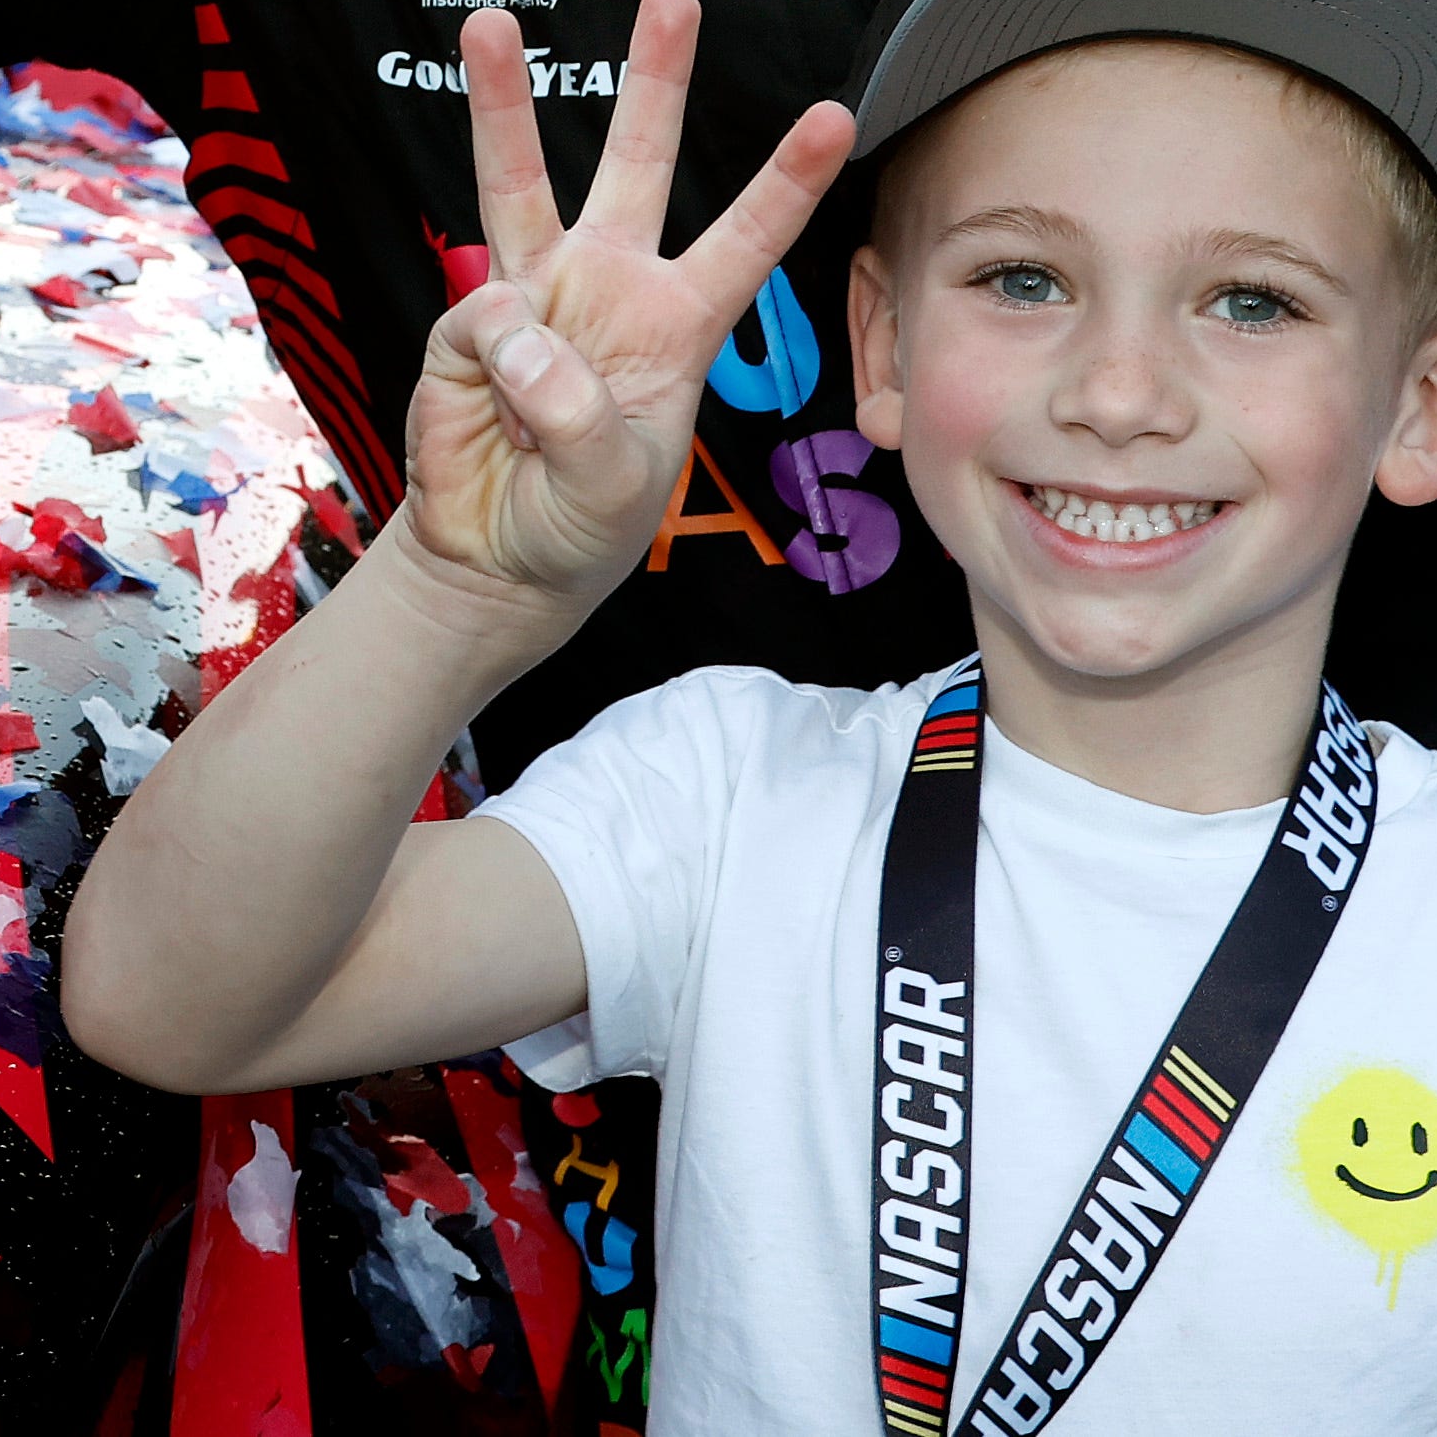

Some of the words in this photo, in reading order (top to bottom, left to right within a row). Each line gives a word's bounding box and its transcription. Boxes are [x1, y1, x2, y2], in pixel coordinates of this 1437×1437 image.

[1281, 676, 1373, 891] ASCAR
[879, 965, 965, 1329] NASCAR
[970, 1145, 1183, 1437] NASCA
